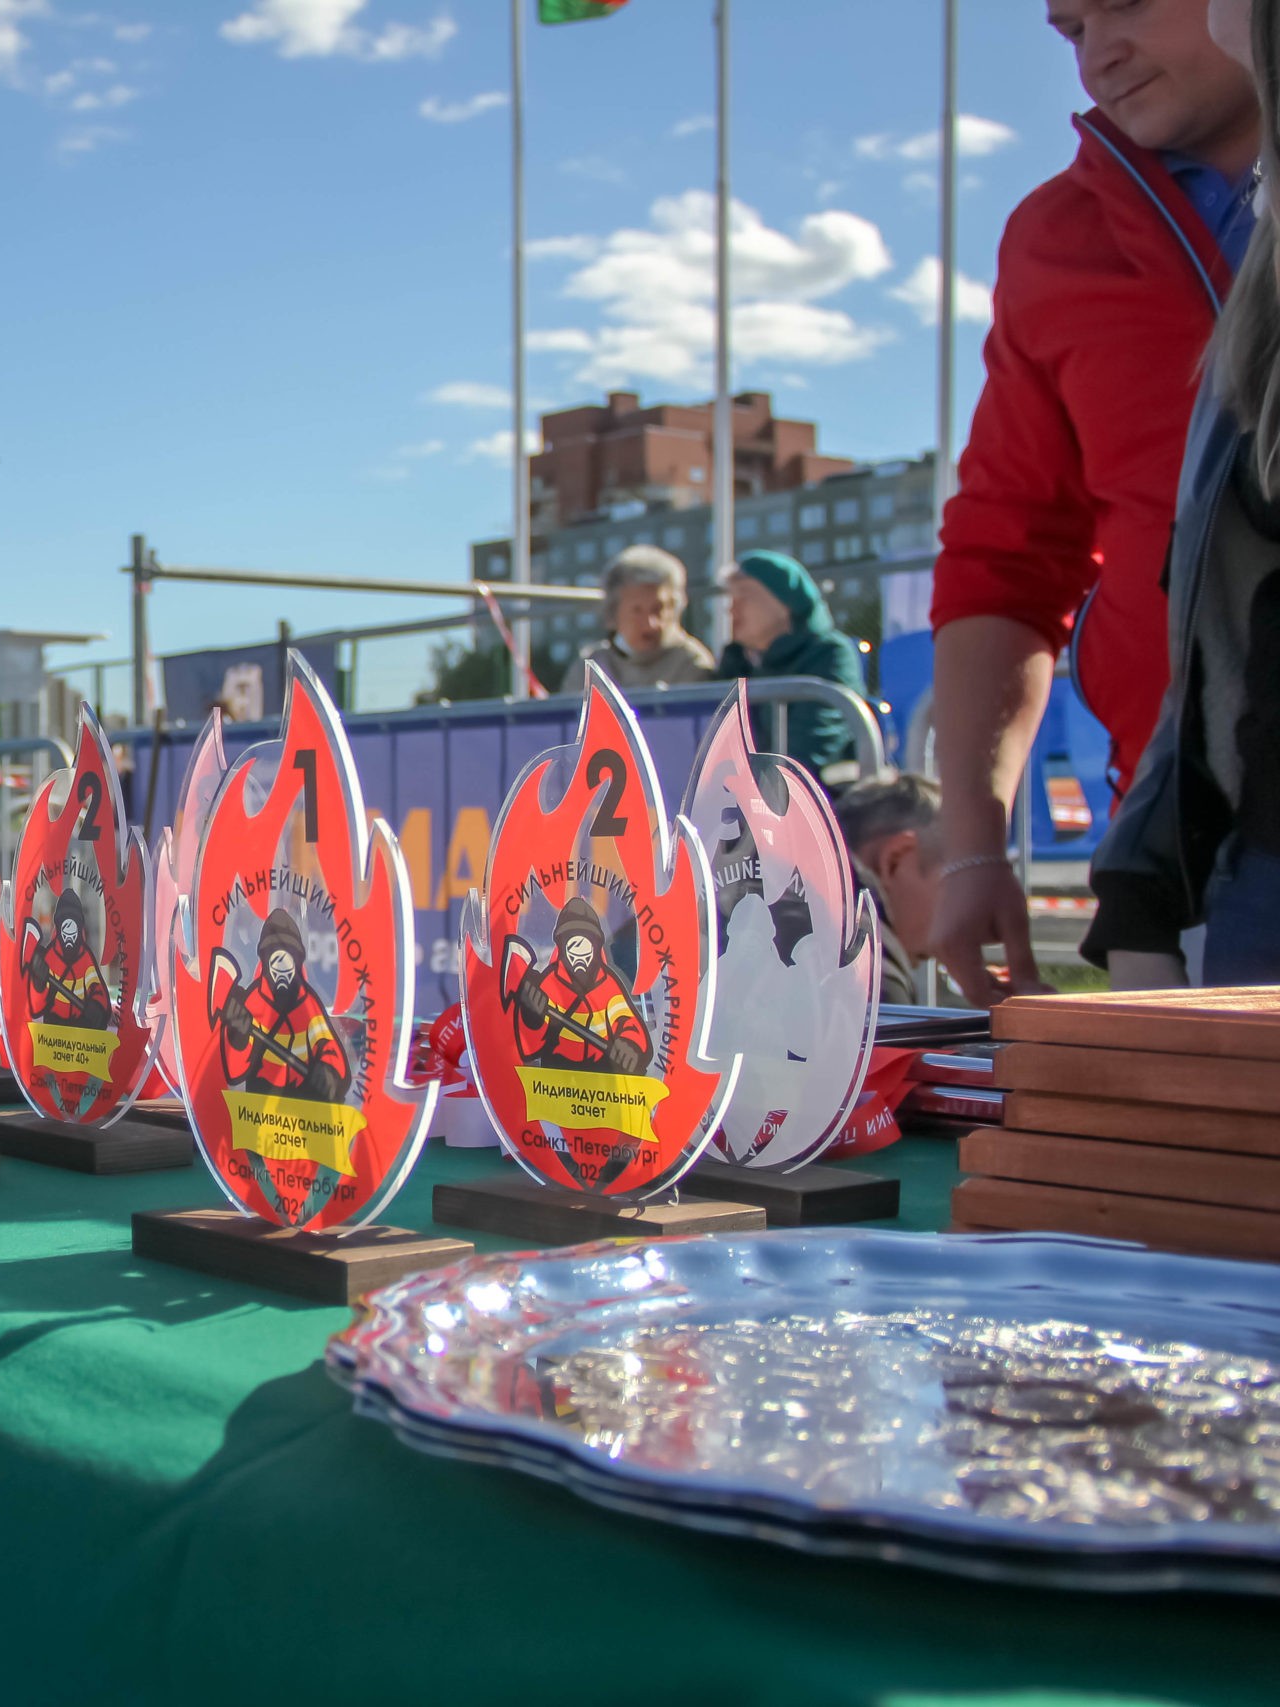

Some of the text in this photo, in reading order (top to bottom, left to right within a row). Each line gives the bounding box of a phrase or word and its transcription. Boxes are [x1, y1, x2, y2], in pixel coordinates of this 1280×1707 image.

[77, 771, 103, 841] 2
[293, 749, 318, 843] 1
[585, 749, 628, 837] 2
[25, 856, 107, 902] СИЛЬНЕЙШИЙ
[212, 864, 377, 1104] СИЛЬНЕЙШИЙ ПОЖАРНЫЙ
[505, 856, 681, 1075] СИЛЬНЕЙШИЙ ПОЖАРНЫЙ
[37, 1033, 107, 1055] Индивидуальный
[53, 1050, 90, 1065] зачет 40+
[532, 1080, 646, 1107] Индивидуальный
[570, 1102, 606, 1118] зачет
[237, 1105, 345, 1137] Индивидуальный
[273, 1131, 308, 1149] зачет
[522, 1130, 659, 1165] Санкт-Петербург
[227, 1159, 358, 1200] Санкт-Петербург
